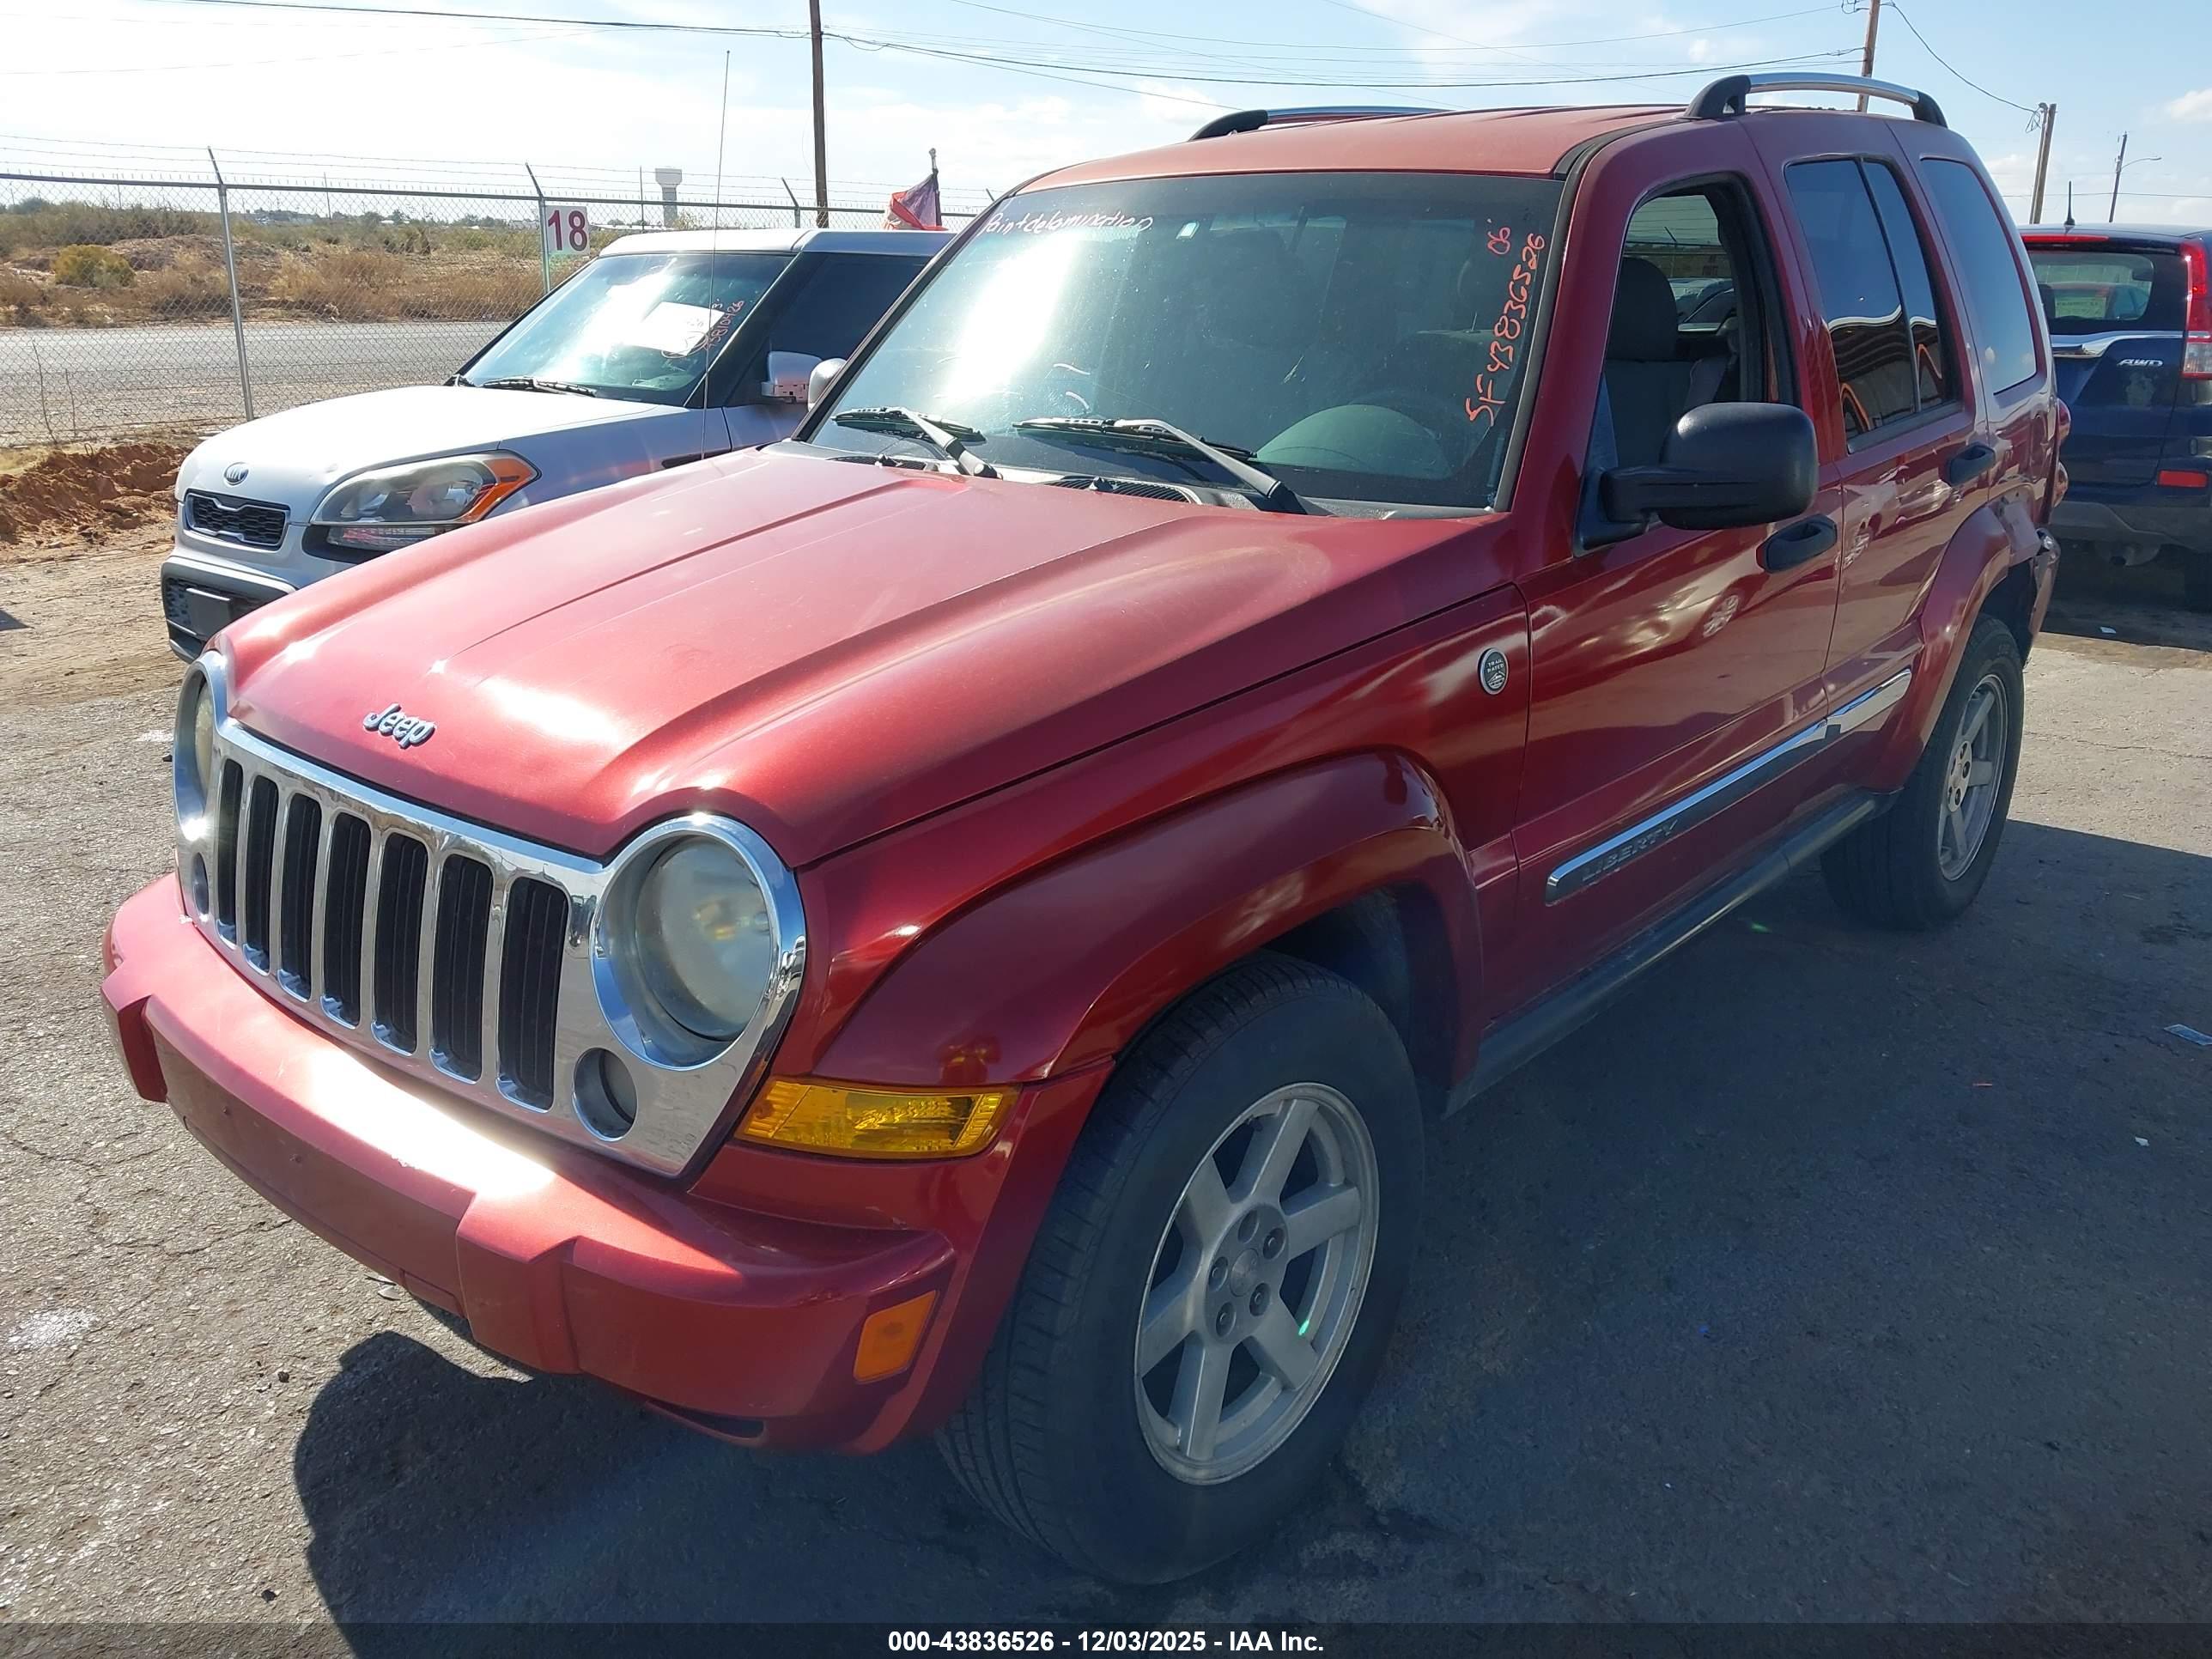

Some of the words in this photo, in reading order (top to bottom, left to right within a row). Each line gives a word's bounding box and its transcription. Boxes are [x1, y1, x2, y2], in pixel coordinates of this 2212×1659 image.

[548, 210, 587, 252] 18
[2116, 357, 2164, 368] AWD
[1486, 659, 1504, 667] TRAIL
[1486, 663, 1504, 673] RATED
[362, 702, 436, 750] Jeep
